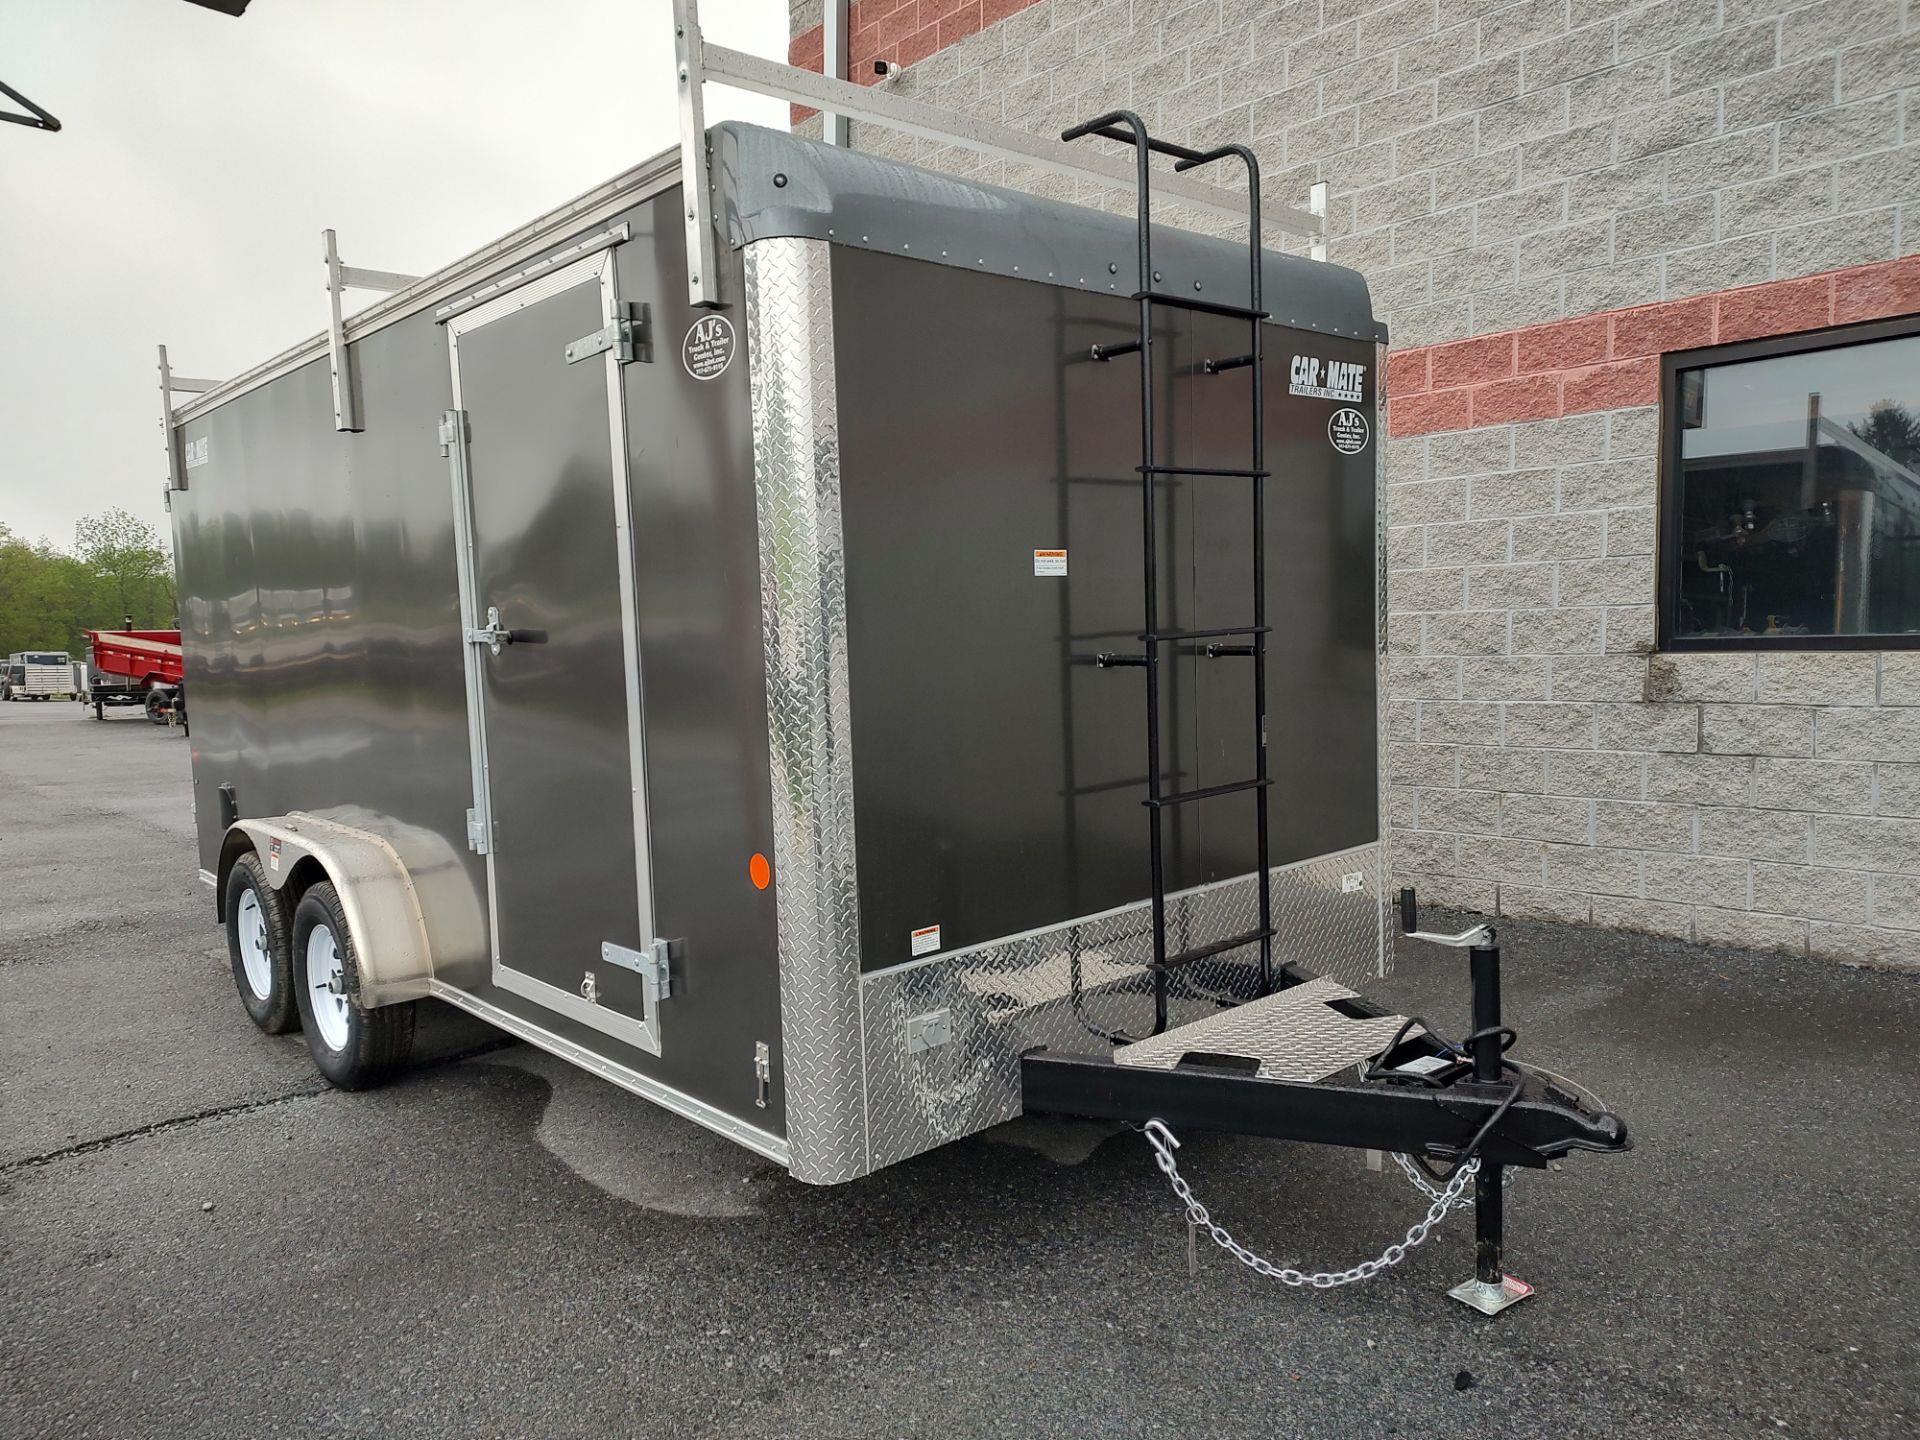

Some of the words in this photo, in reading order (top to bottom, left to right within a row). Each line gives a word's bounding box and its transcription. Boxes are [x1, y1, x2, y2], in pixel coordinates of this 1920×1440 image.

[695, 320, 723, 344] AJ's
[688, 344, 705, 354] Truck
[711, 337, 729, 347] Trailer
[1290, 355, 1320, 387] CAR
[1327, 360, 1364, 393] MATE
[1291, 384, 1323, 396] TRAILERS
[1338, 411, 1360, 426] AJ's
